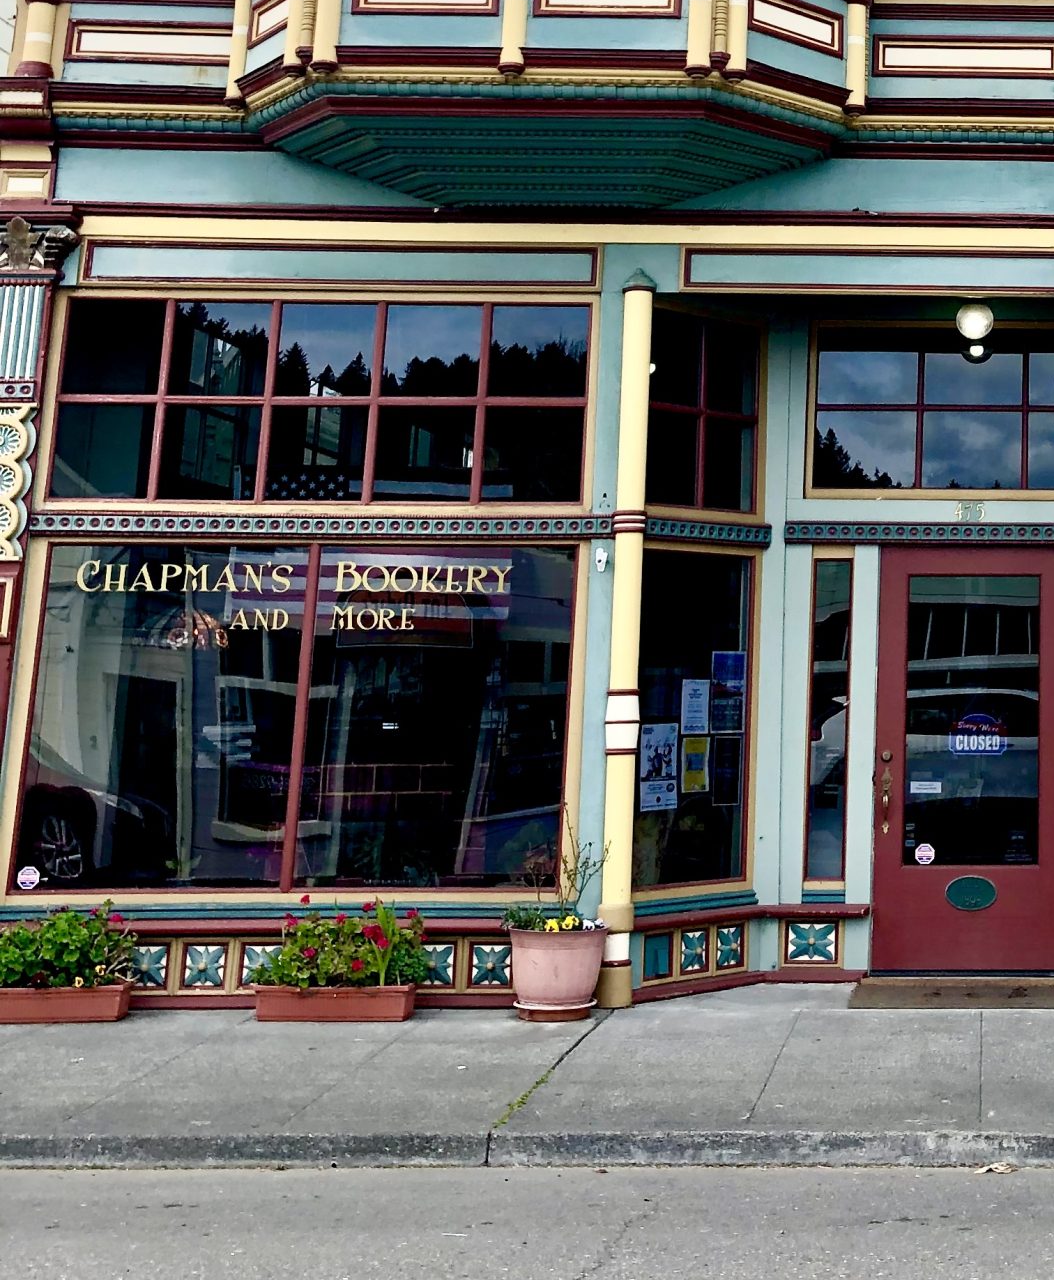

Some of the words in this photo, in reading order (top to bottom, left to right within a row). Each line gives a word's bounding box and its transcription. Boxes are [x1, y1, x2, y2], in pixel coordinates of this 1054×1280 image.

[954, 502, 985, 521] 475
[76, 559, 294, 595] CHAPMAN'S
[333, 561, 515, 594] BOOKERY
[228, 607, 289, 632] AND
[329, 605, 415, 631] MORE
[955, 733, 1000, 751] CLOSED
